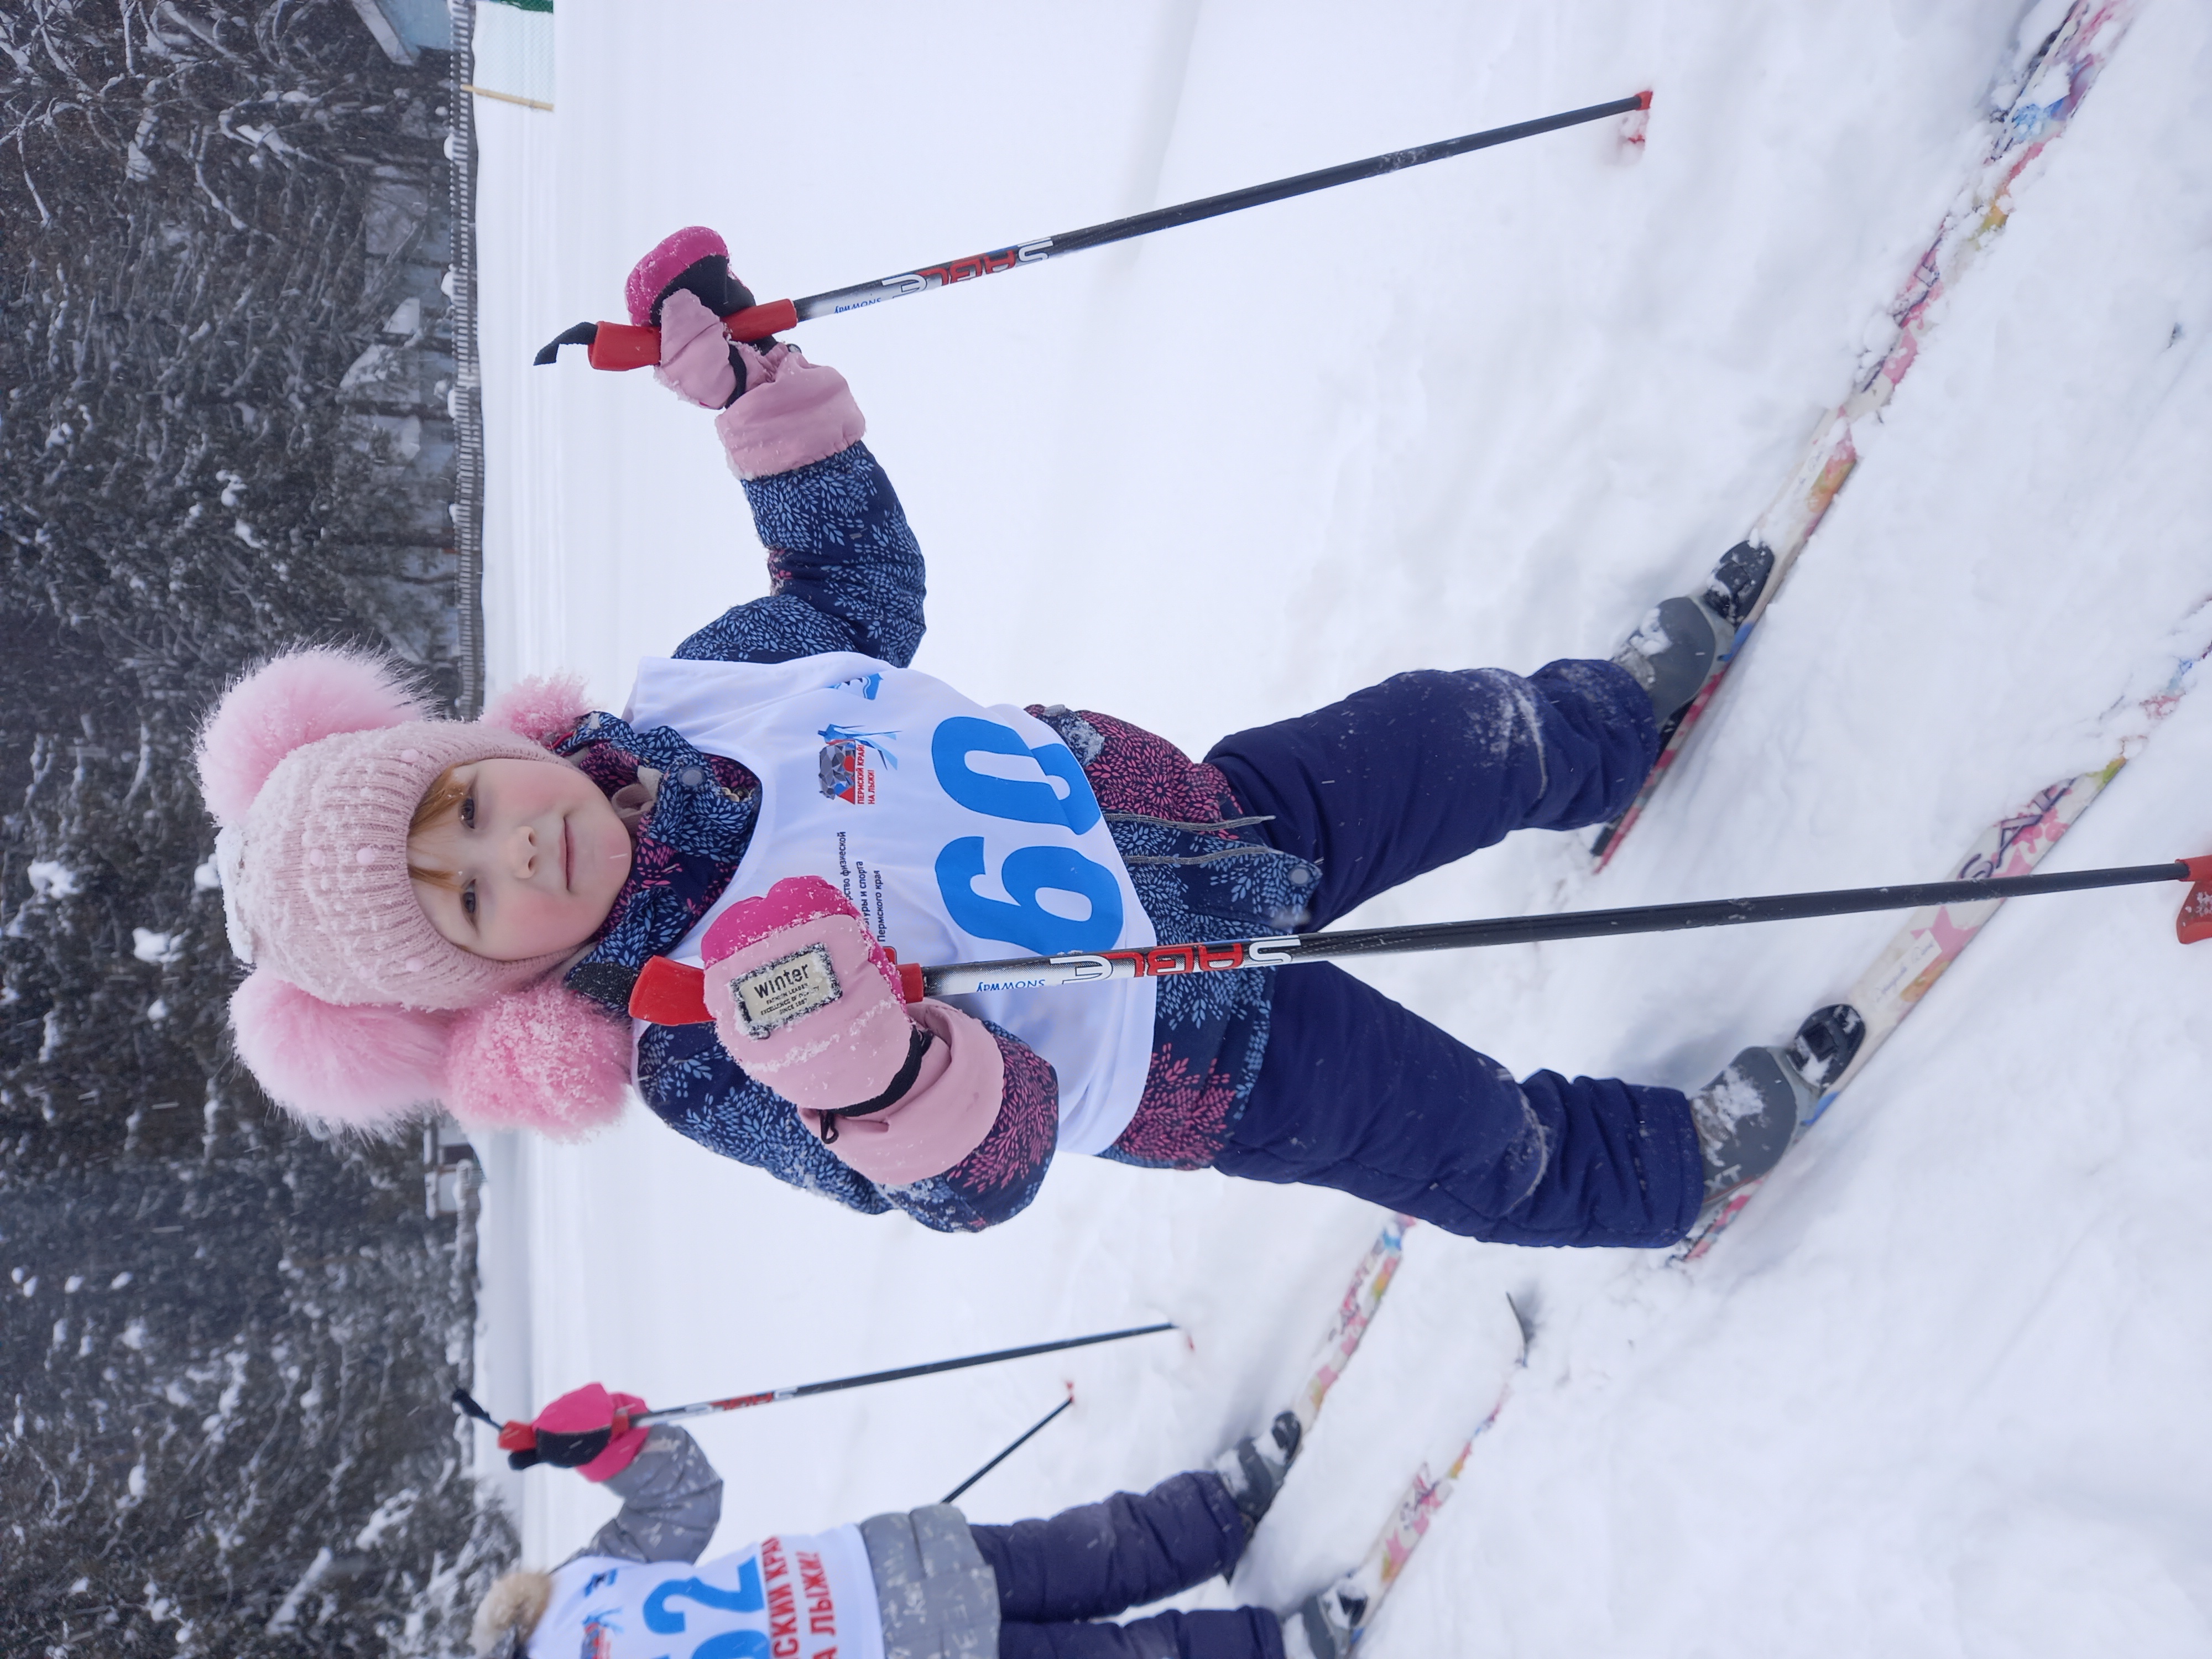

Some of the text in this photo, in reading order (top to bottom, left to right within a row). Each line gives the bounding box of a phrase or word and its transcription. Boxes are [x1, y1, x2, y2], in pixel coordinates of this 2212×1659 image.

[856, 768, 864, 804] ПЕРМСКИЙ
[868, 794, 875, 804] НА
[931, 716, 1124, 957] 60
[857, 861, 867, 889] спорта
[874, 870, 887, 942] Пермского края
[1050, 936, 1301, 985] SABLE
[796, 1552, 836, 1636] ЛЫЖИ!
